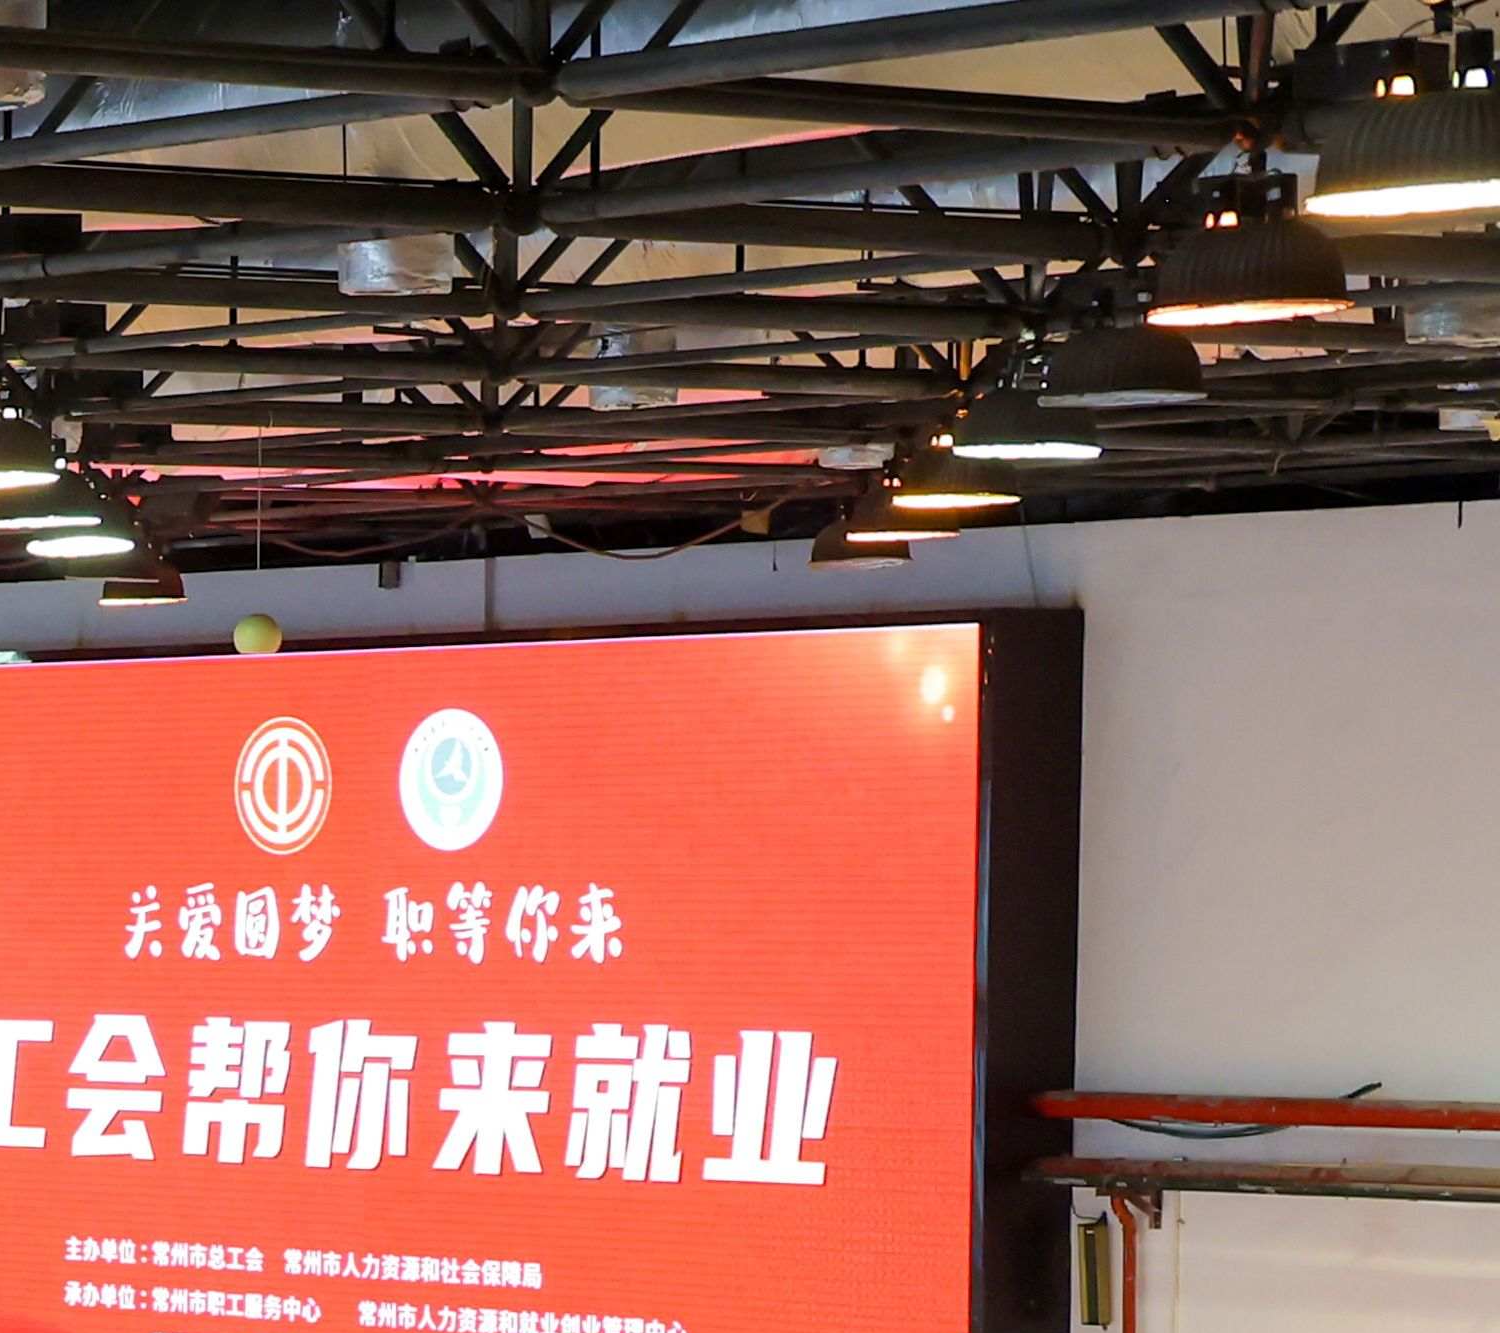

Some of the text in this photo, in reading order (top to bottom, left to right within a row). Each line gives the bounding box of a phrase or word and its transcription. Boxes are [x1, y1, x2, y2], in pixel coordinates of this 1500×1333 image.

[123, 882, 625, 966] 关爱圆梦 职等你来
[284, 1251, 543, 1291] 常州市人力资源和社会保障局
